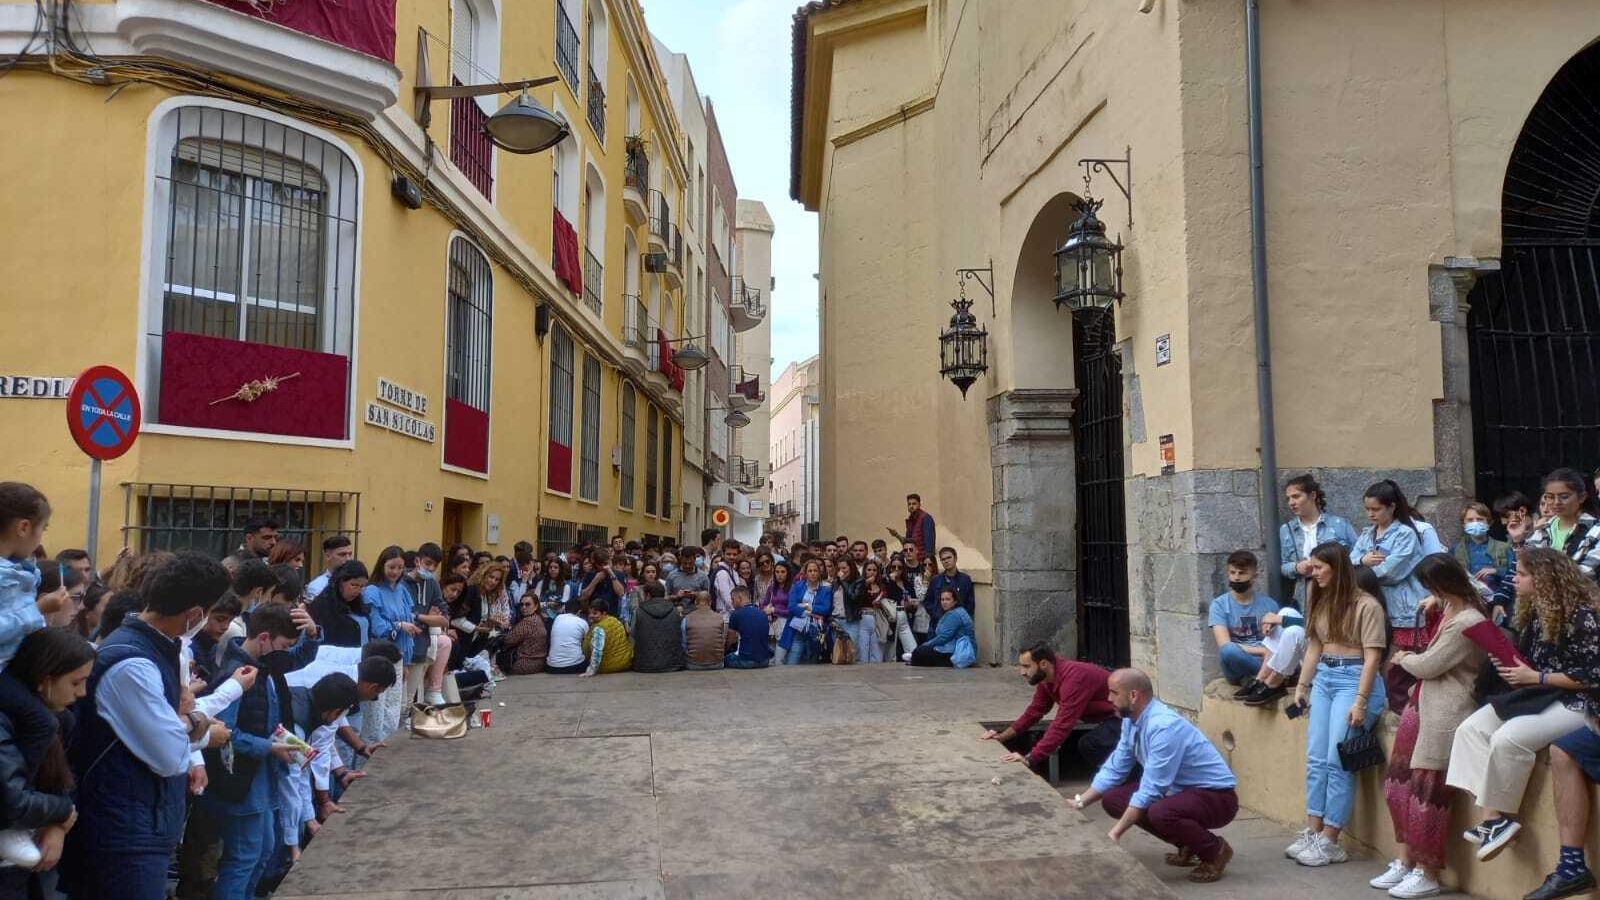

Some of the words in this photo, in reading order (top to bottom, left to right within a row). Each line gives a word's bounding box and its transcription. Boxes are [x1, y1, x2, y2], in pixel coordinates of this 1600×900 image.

[0, 376, 75, 397] REDI
[81, 404, 90, 412] EN
[90, 405, 106, 416] TODA
[106, 409, 114, 417] LA
[113, 411, 131, 421] CALLE
[415, 394, 427, 413] DE
[368, 404, 389, 426] SAN
